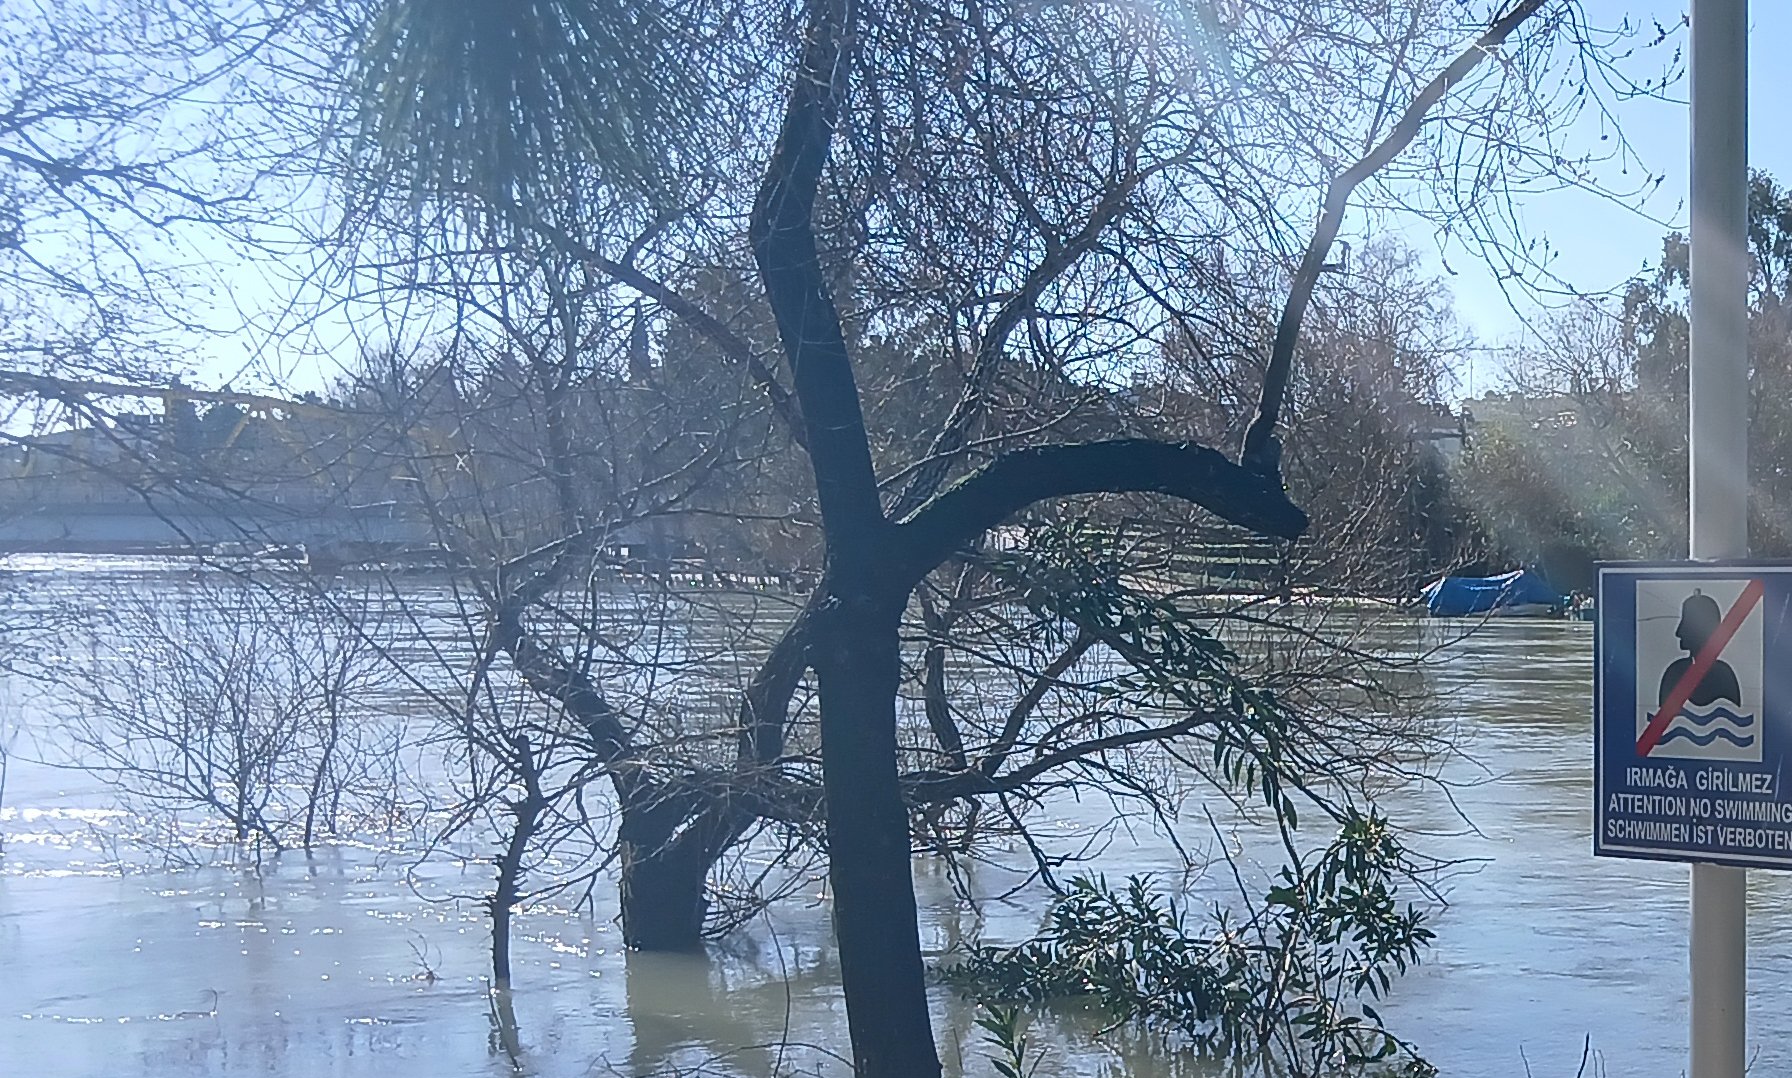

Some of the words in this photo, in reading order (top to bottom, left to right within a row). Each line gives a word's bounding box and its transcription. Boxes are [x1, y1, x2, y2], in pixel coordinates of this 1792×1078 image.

[1626, 766, 1688, 790] IRMAĞA
[1696, 767, 1773, 794] GİRİLMEZ
[1609, 793, 1686, 816] ATTENTION
[1690, 798, 1711, 818] NO
[1715, 800, 1792, 823] SWIMMING
[1607, 819, 1689, 843] SCHWIMMEN
